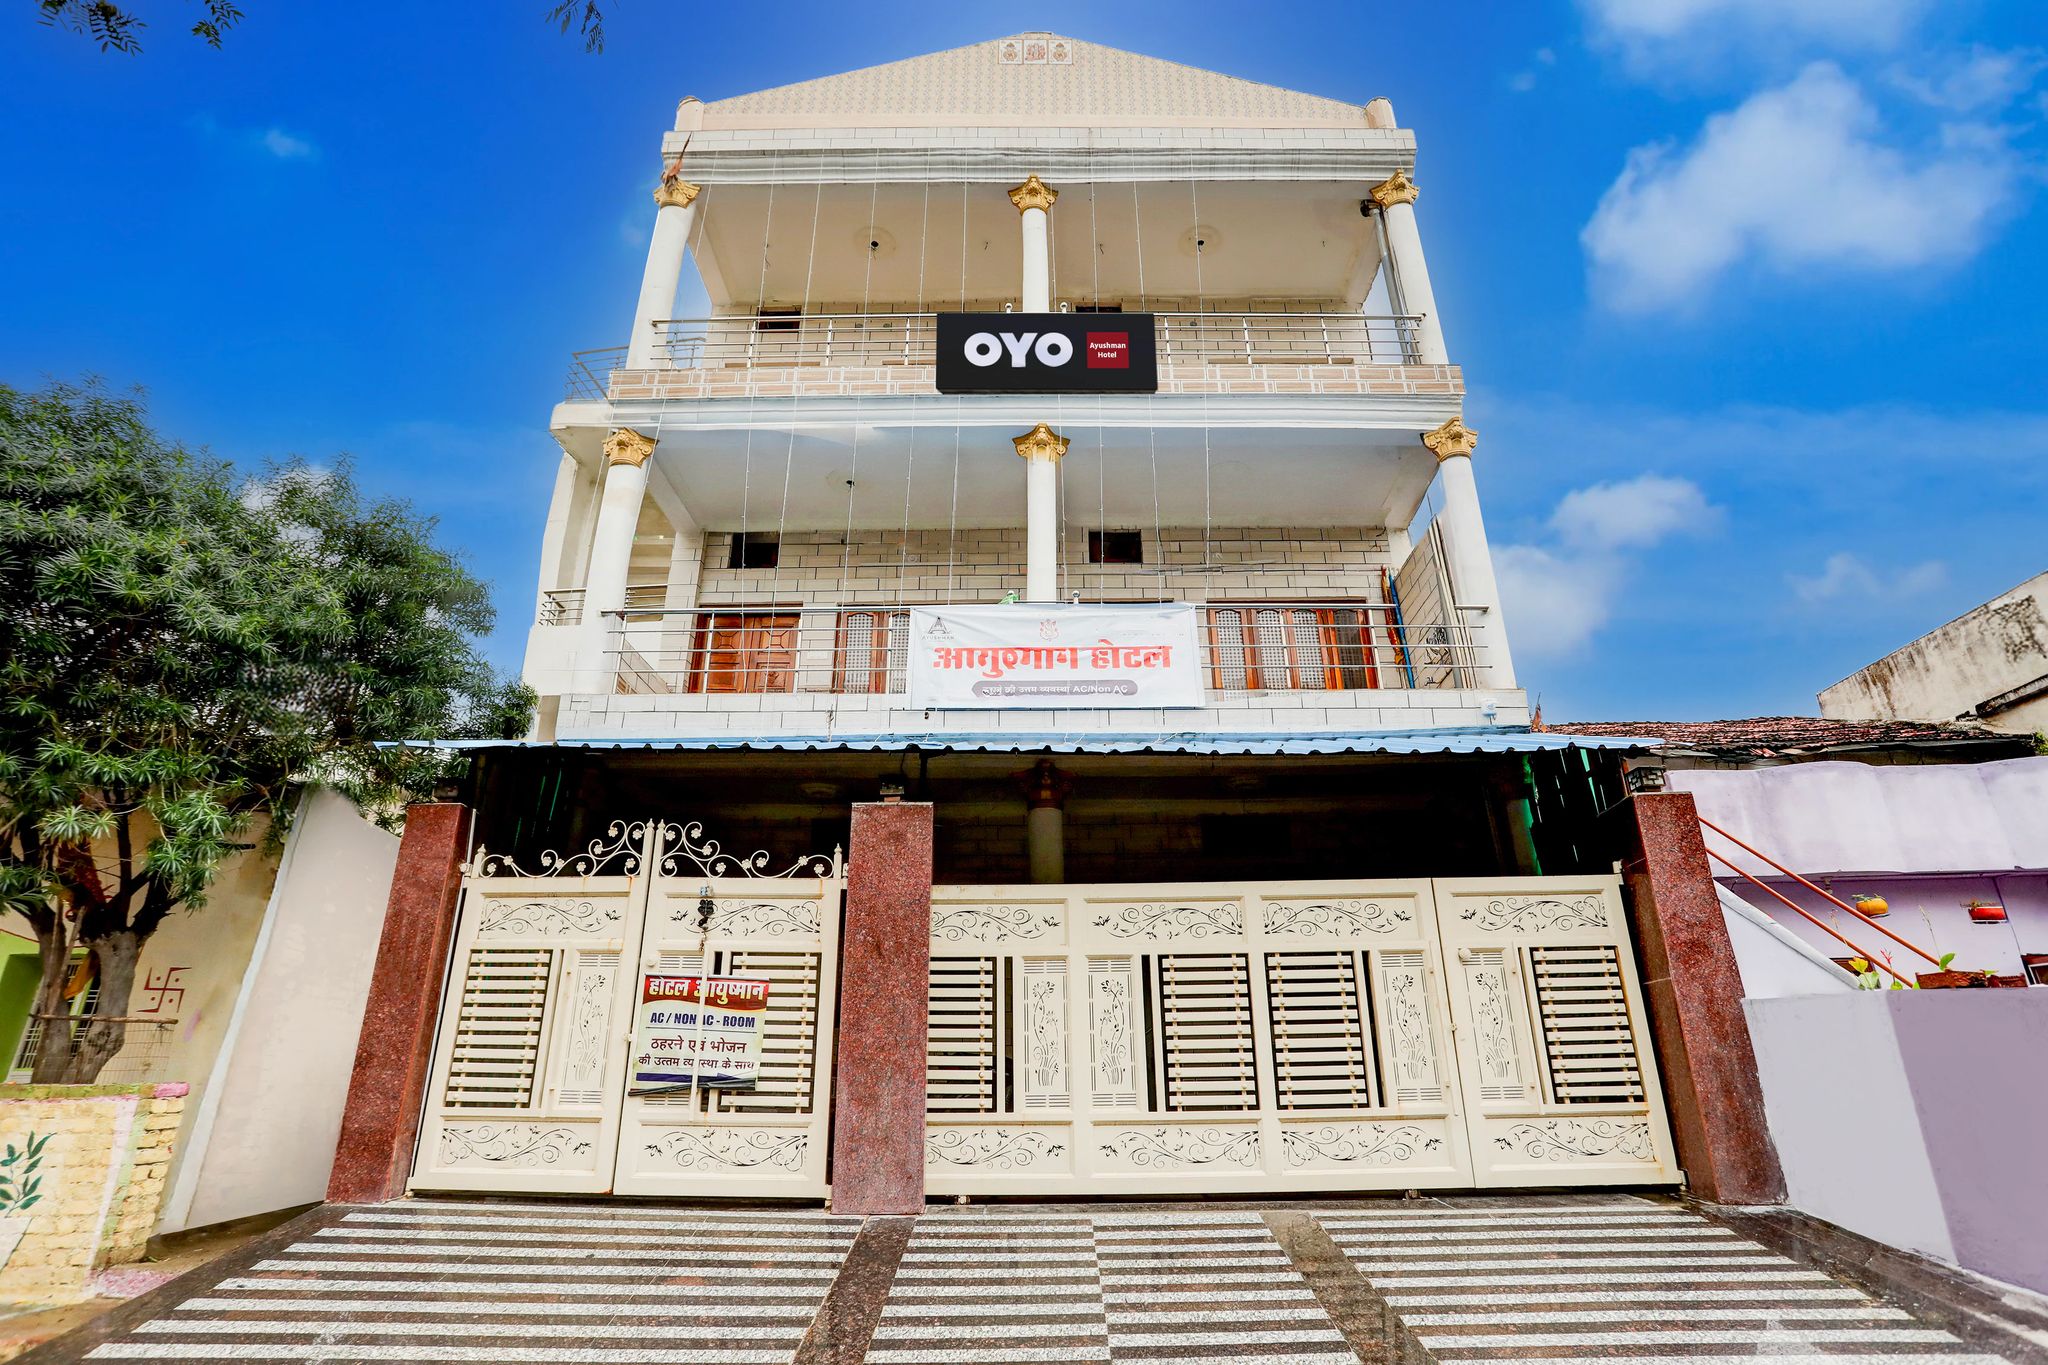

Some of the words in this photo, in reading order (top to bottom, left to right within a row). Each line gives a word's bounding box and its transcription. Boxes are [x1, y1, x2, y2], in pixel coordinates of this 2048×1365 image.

[964, 332, 1074, 367] OYO
[1090, 342, 1126, 350] Ayushman
[1097, 350, 1117, 358] Hotel
[1091, 639, 1174, 669] होटल
[648, 977, 691, 996] होटल
[650, 1012, 664, 1023] AC
[674, 1013, 697, 1025] NON
[702, 1014, 714, 1026] C
[722, 1016, 755, 1028] ROOM
[651, 1035, 684, 1050] ठहरने
[710, 1036, 747, 1053] भोजन
[638, 1053, 651, 1065] की
[654, 1056, 680, 1067] उत्तम
[721, 1056, 732, 1069] के
